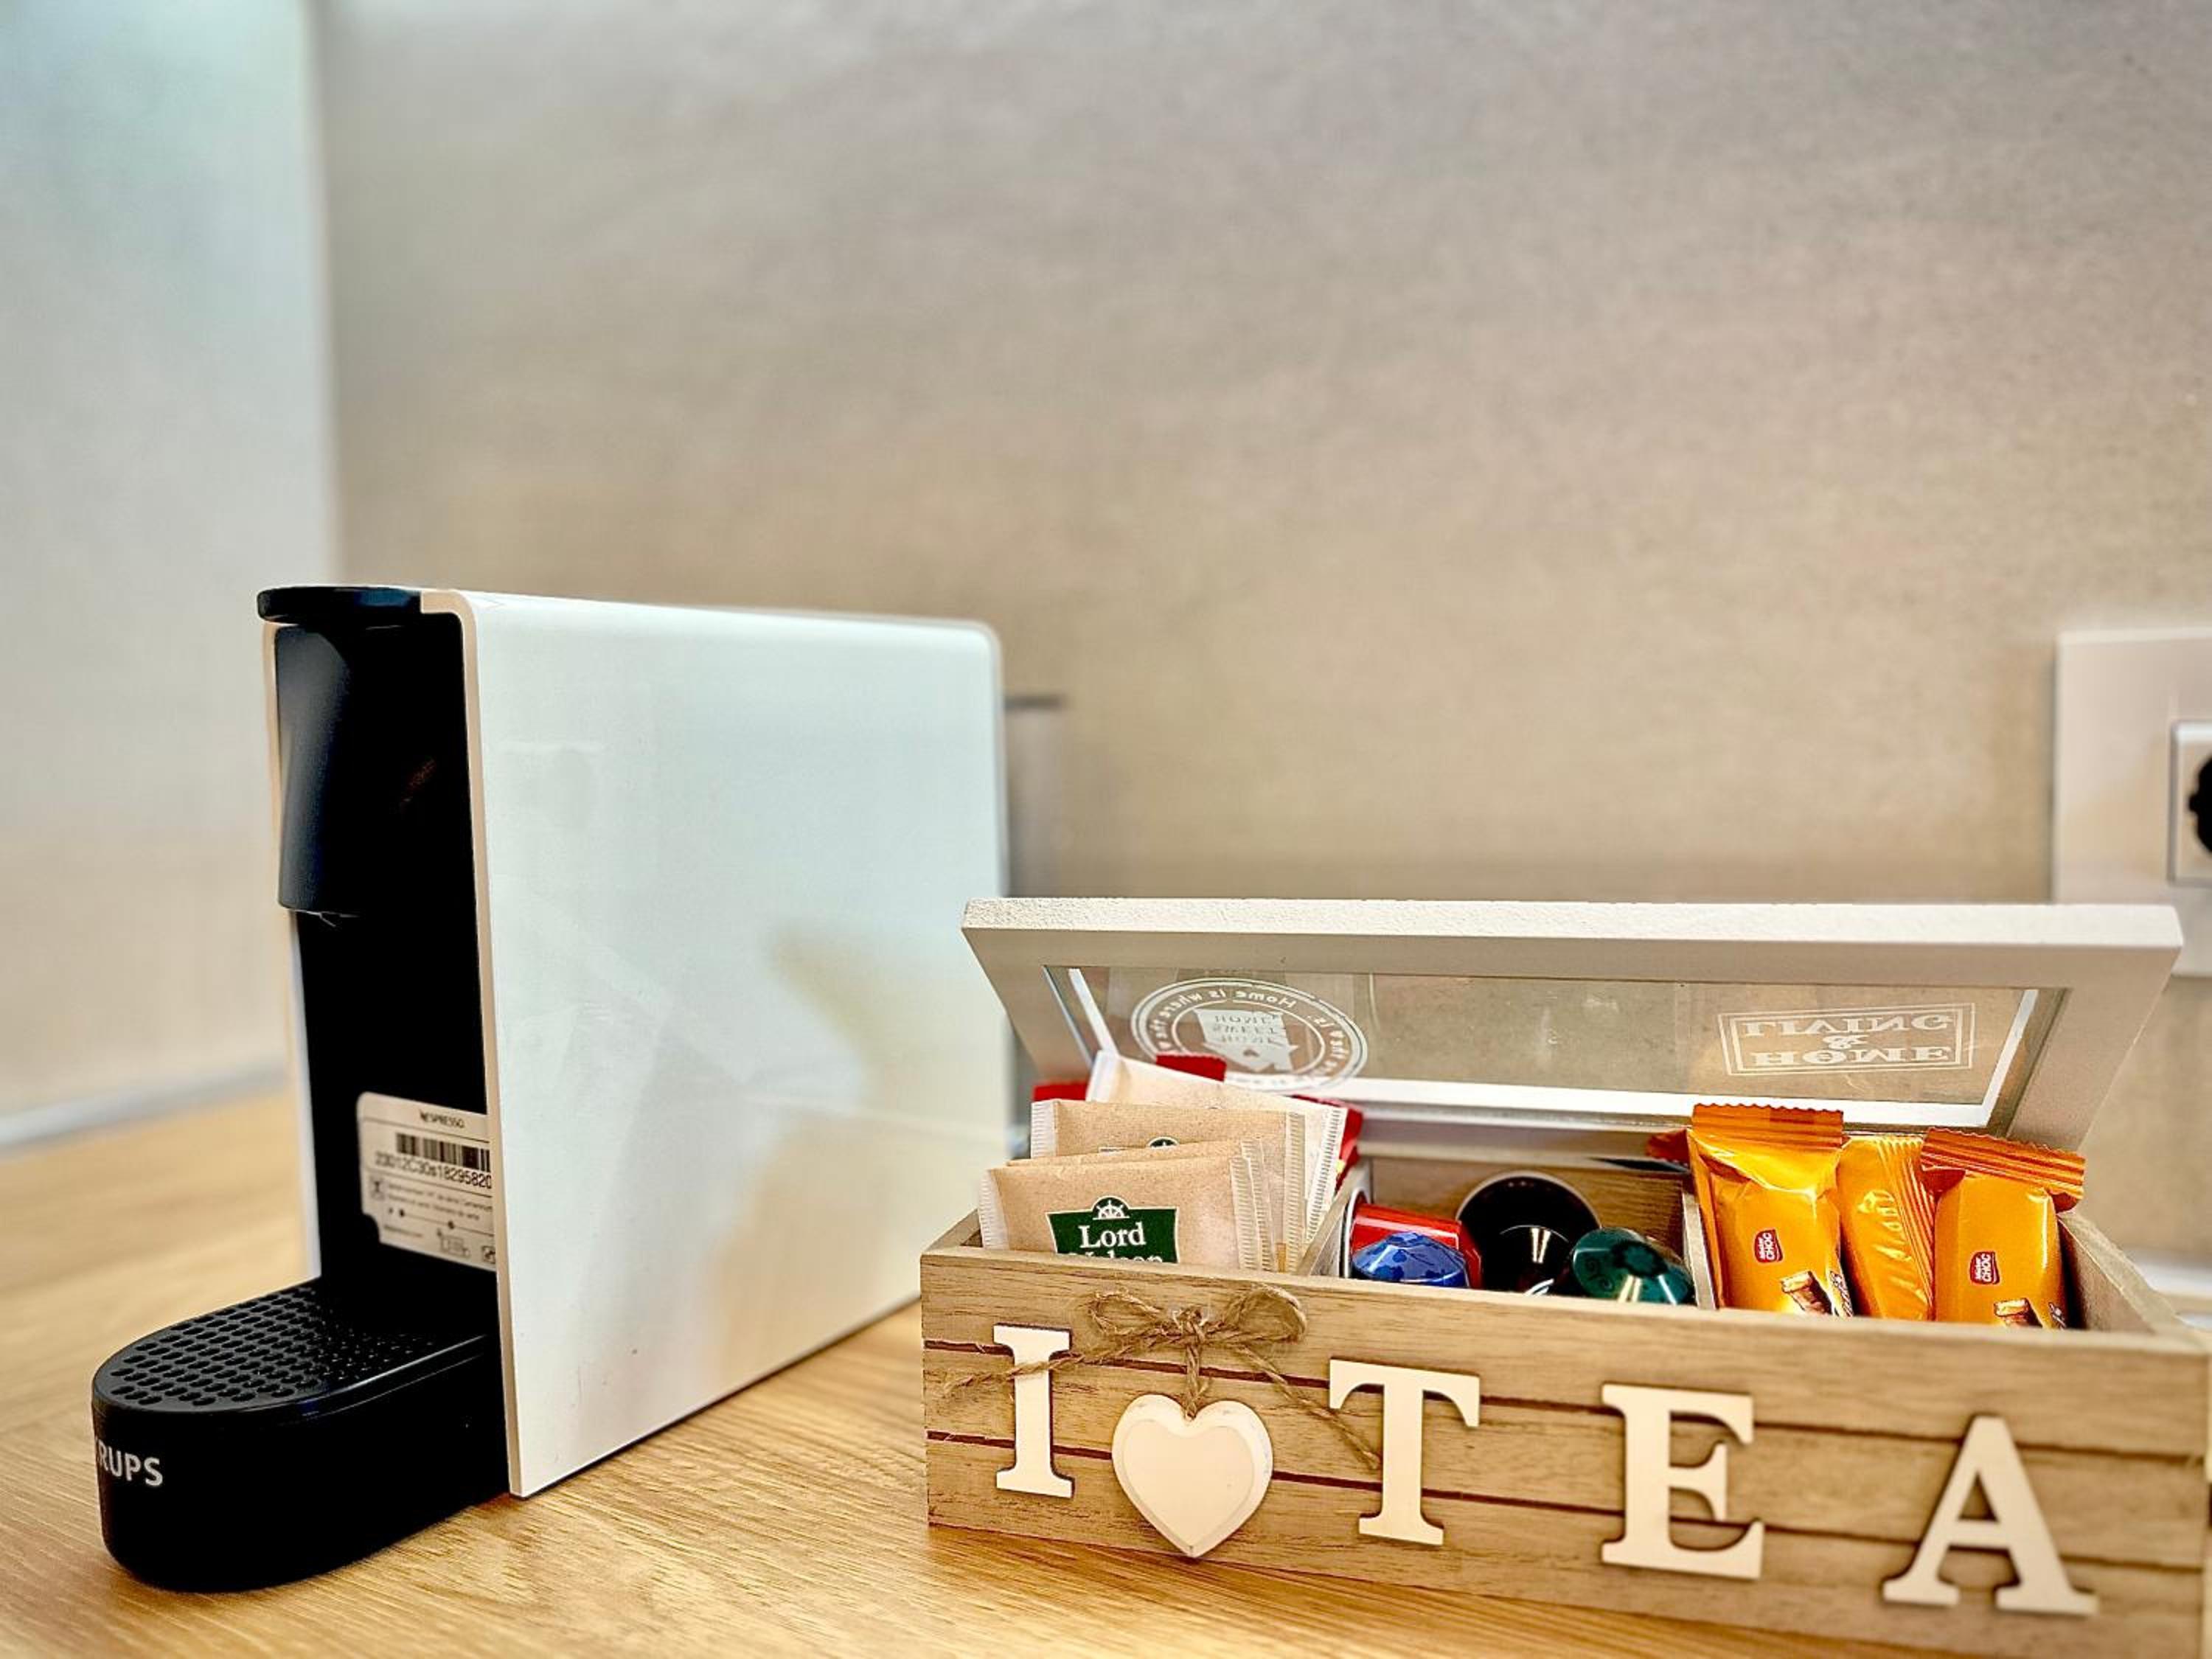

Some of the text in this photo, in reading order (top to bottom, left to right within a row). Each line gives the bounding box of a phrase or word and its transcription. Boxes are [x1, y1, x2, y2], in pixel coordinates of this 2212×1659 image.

[1077, 1221, 1147, 1248] Lord
[1763, 1232, 1775, 1260] CHOC
[1981, 1253, 1991, 1282] CHOC
[992, 1324, 1074, 1498] I
[96, 1436, 163, 1486] RUPS
